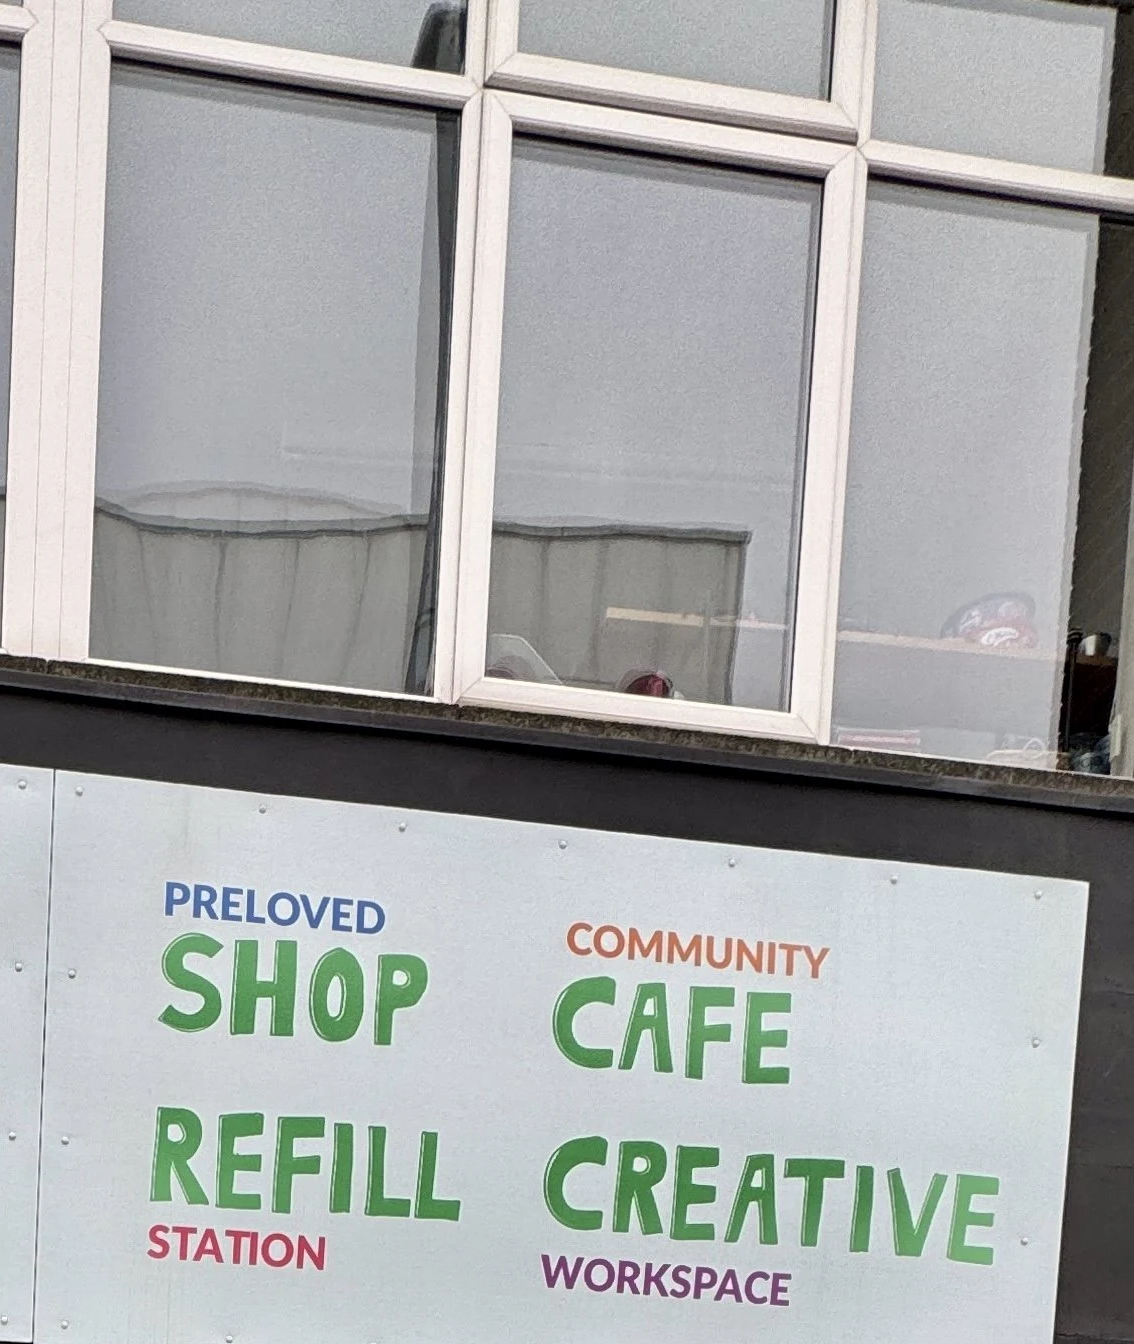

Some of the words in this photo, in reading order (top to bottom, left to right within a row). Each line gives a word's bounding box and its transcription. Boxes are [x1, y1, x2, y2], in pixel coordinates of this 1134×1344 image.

[164, 881, 386, 935] PRELOVED
[157, 931, 429, 1046] SHOP
[566, 922, 831, 979] COMMUNITY
[552, 975, 792, 1085] CAFE
[149, 1106, 461, 1222] REFILL
[543, 1135, 1000, 1266] CREATIVE
[147, 1224, 326, 1271] STATION
[540, 1253, 793, 1307] WORKSPACE
